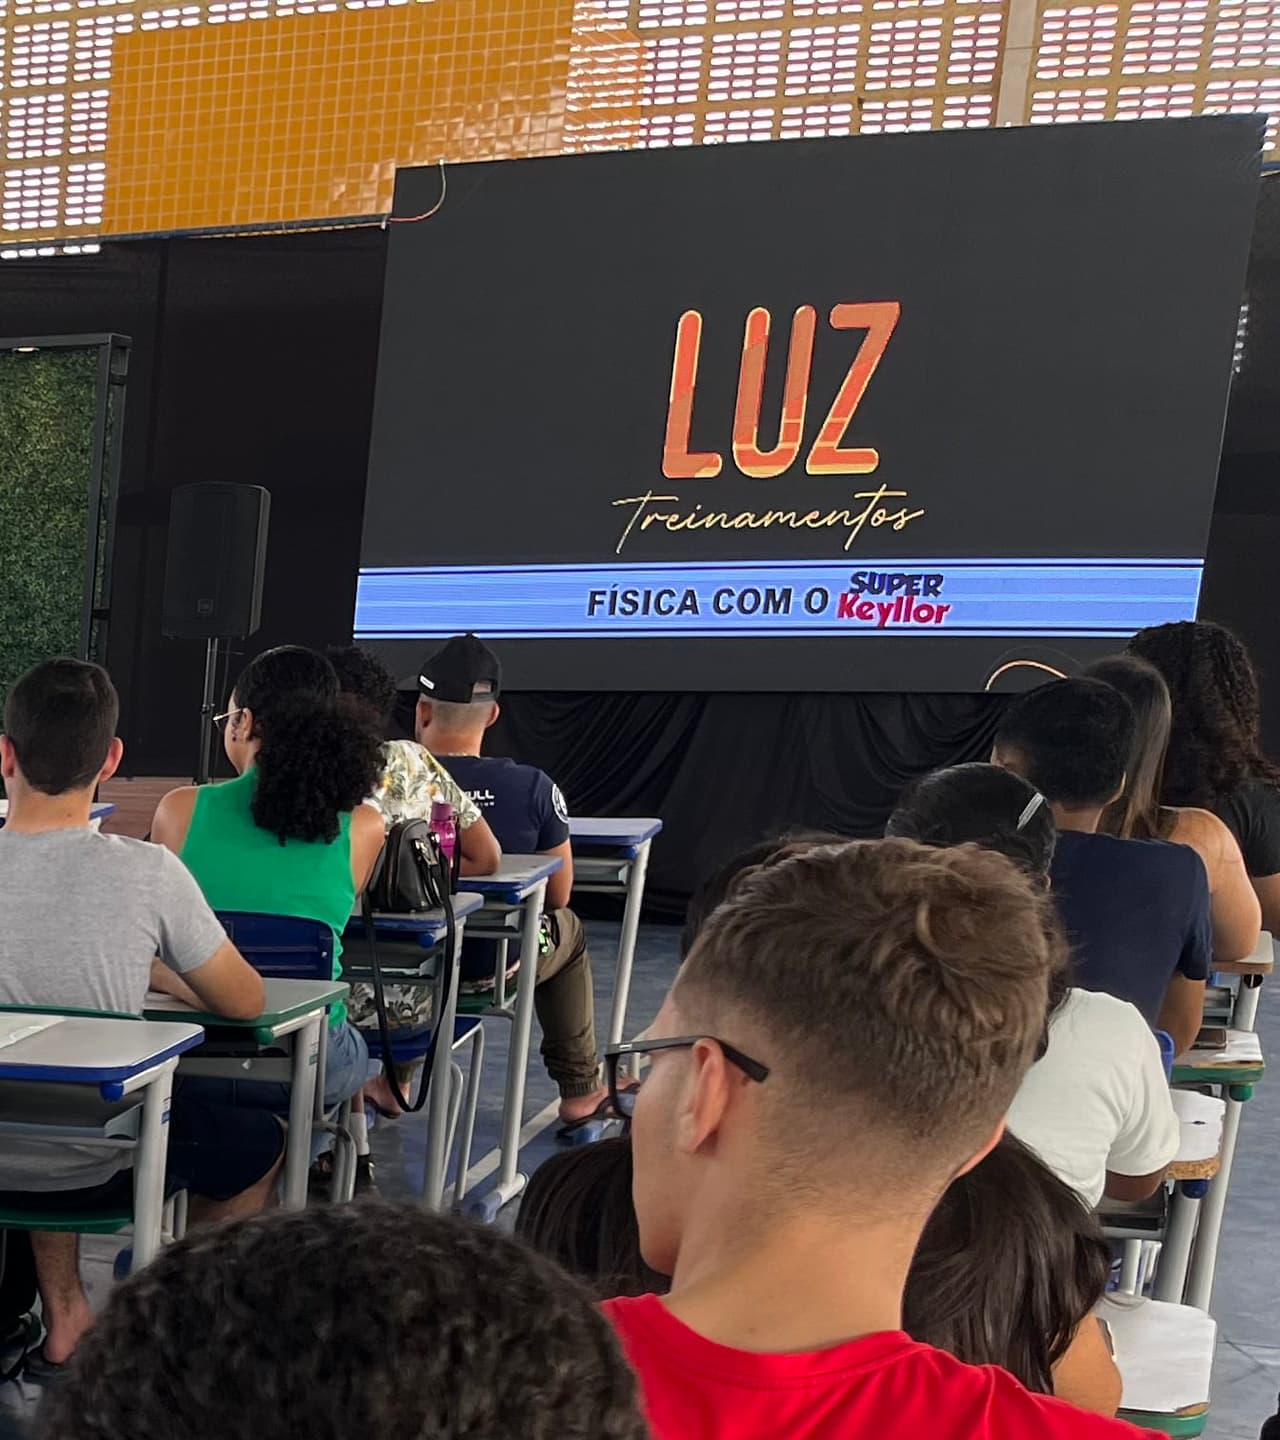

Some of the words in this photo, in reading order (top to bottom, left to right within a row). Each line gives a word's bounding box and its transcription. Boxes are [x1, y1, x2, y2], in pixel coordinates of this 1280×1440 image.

[660, 300, 902, 480] LUZ
[611, 484, 925, 555] Treinamentos
[587, 583, 700, 617] FÍSICA
[712, 587, 792, 615] COM
[804, 587, 829, 615] O
[848, 570, 944, 598] SUPER
[836, 592, 951, 628] Keyllor
